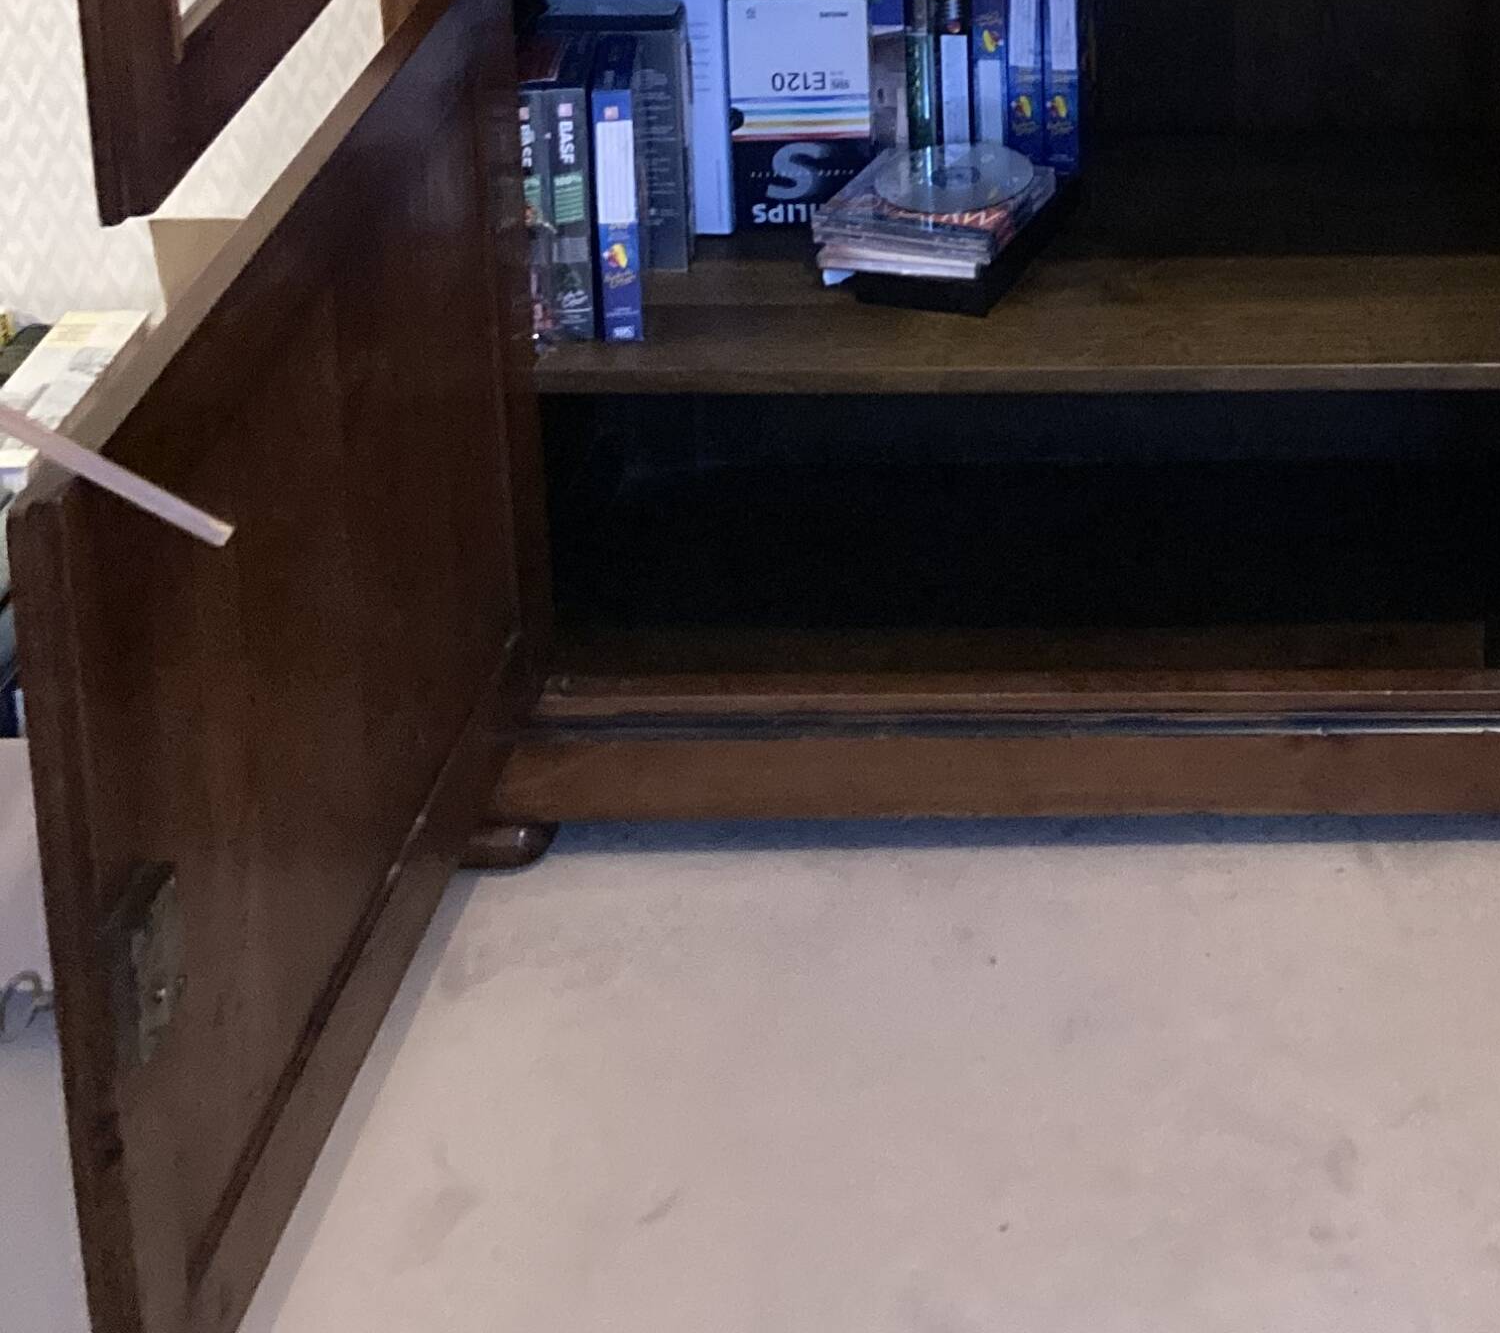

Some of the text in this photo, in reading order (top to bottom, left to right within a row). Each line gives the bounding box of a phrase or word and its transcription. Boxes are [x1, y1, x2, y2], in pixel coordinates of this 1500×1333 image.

[771, 71, 826, 93] E120
[557, 120, 576, 165] BASF
[751, 202, 817, 224] ILIPS
